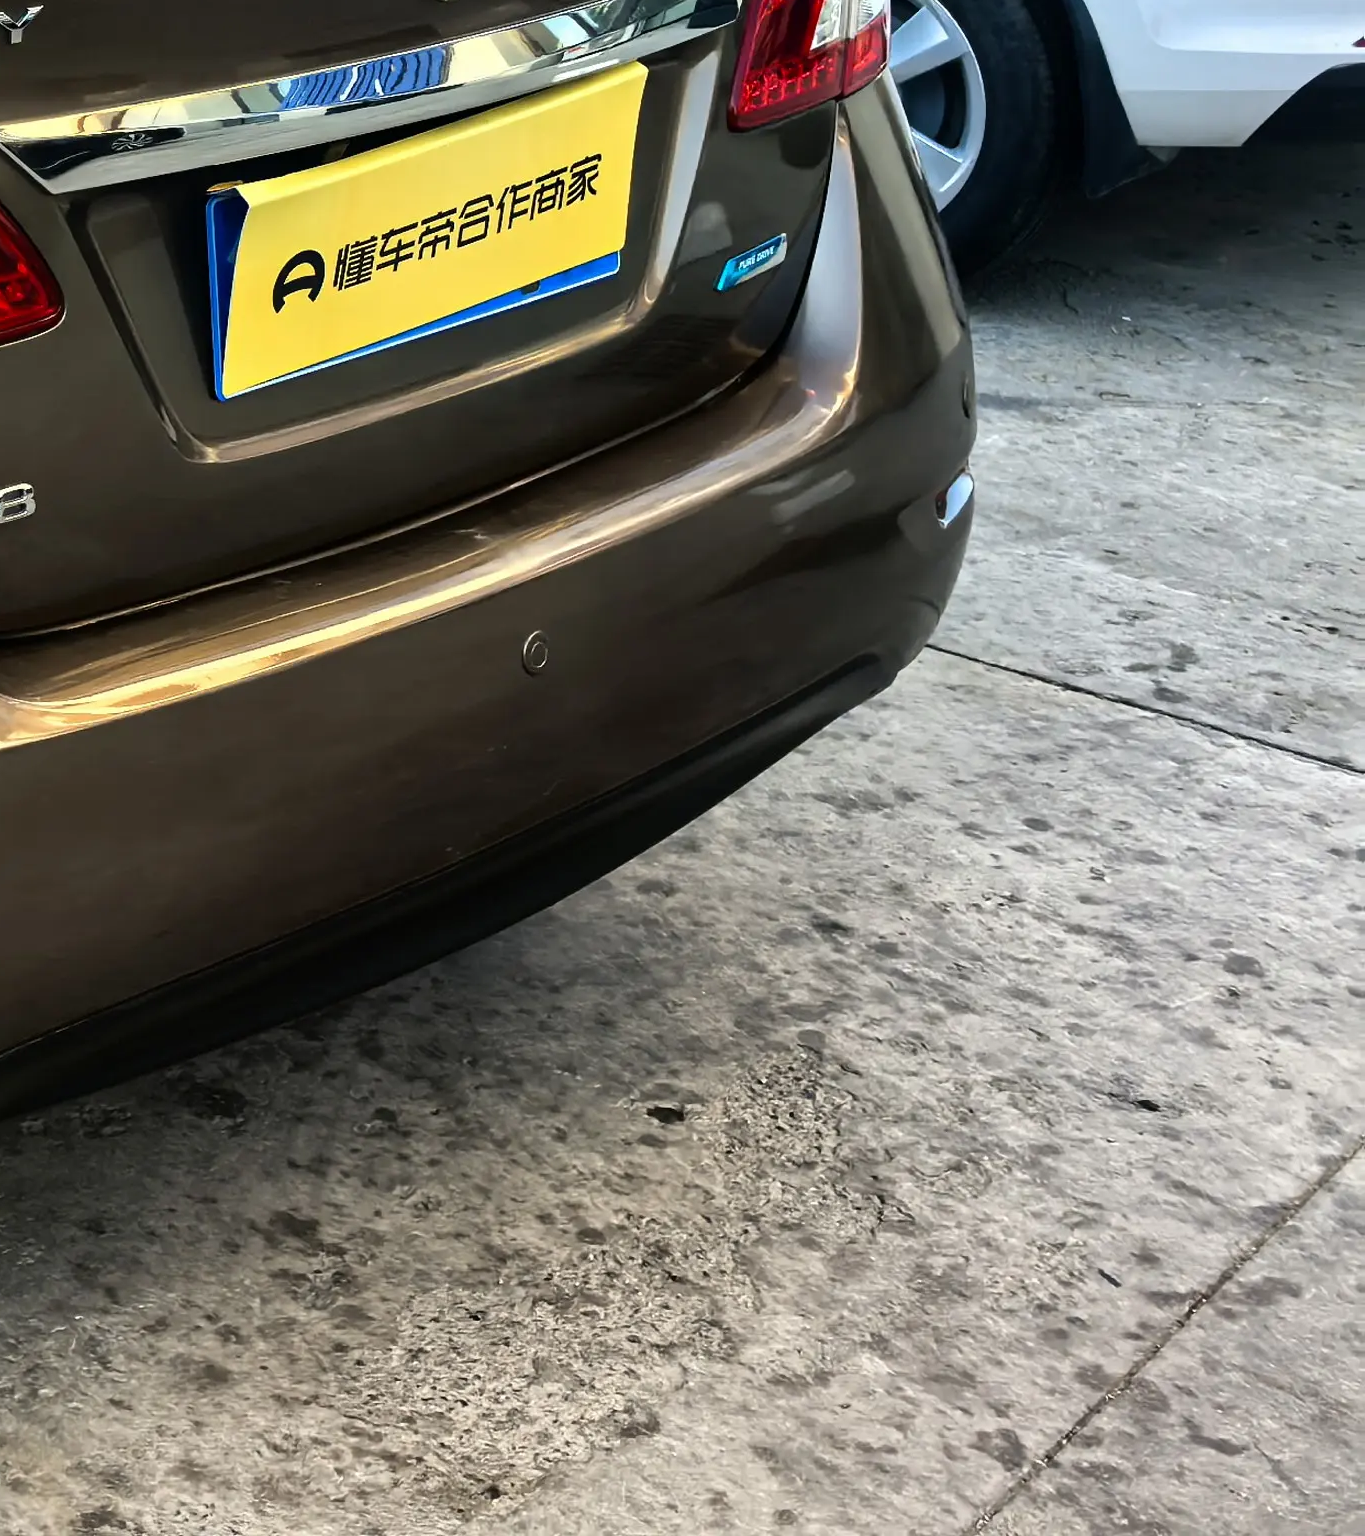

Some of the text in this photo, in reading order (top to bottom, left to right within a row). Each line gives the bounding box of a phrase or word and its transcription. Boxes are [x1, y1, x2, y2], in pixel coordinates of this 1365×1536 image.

[332, 154, 602, 292] 懂车帝合作商家
